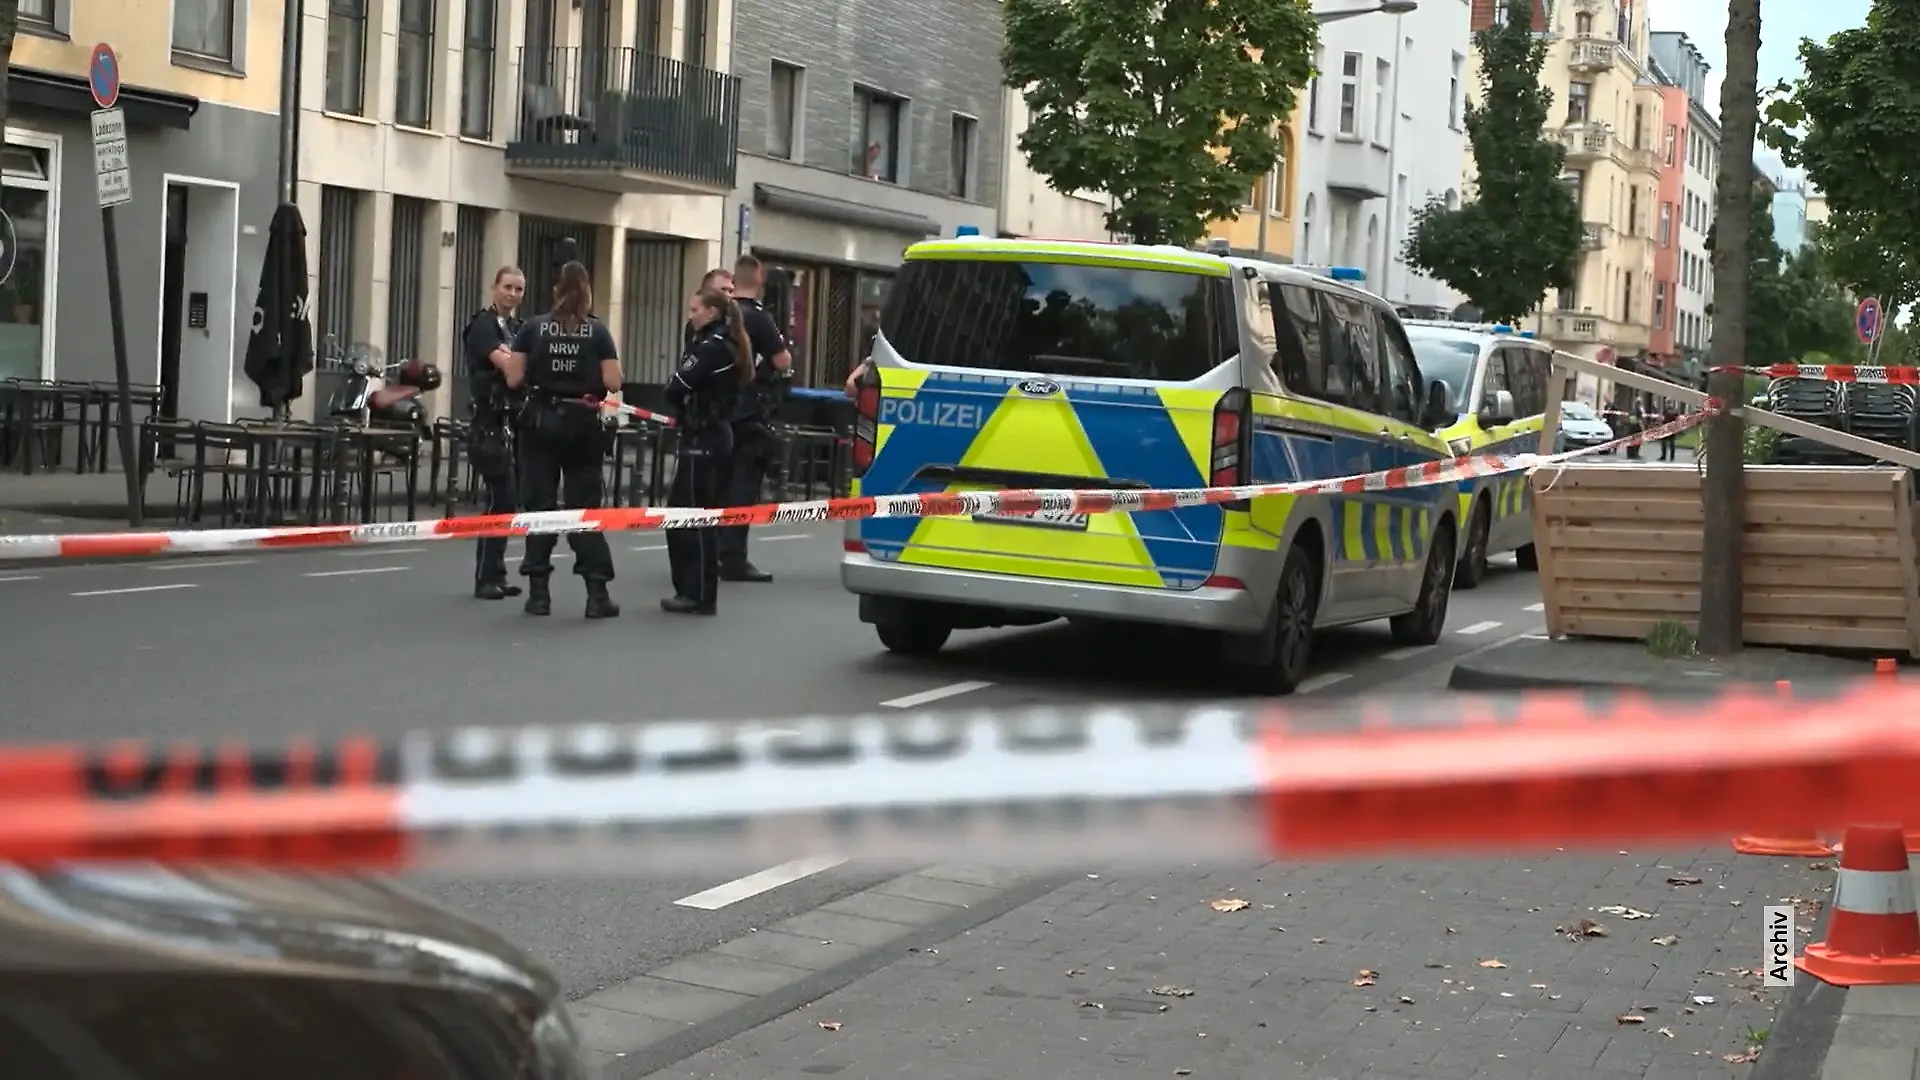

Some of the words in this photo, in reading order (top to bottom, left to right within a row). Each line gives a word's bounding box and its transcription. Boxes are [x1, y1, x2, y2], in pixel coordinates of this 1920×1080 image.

[540, 321, 593, 338] POLZEI
[549, 343, 580, 355] NRW
[552, 359, 577, 372] DHF
[1024, 382, 1051, 395] Ford
[881, 398, 983, 429] POLIZEI
